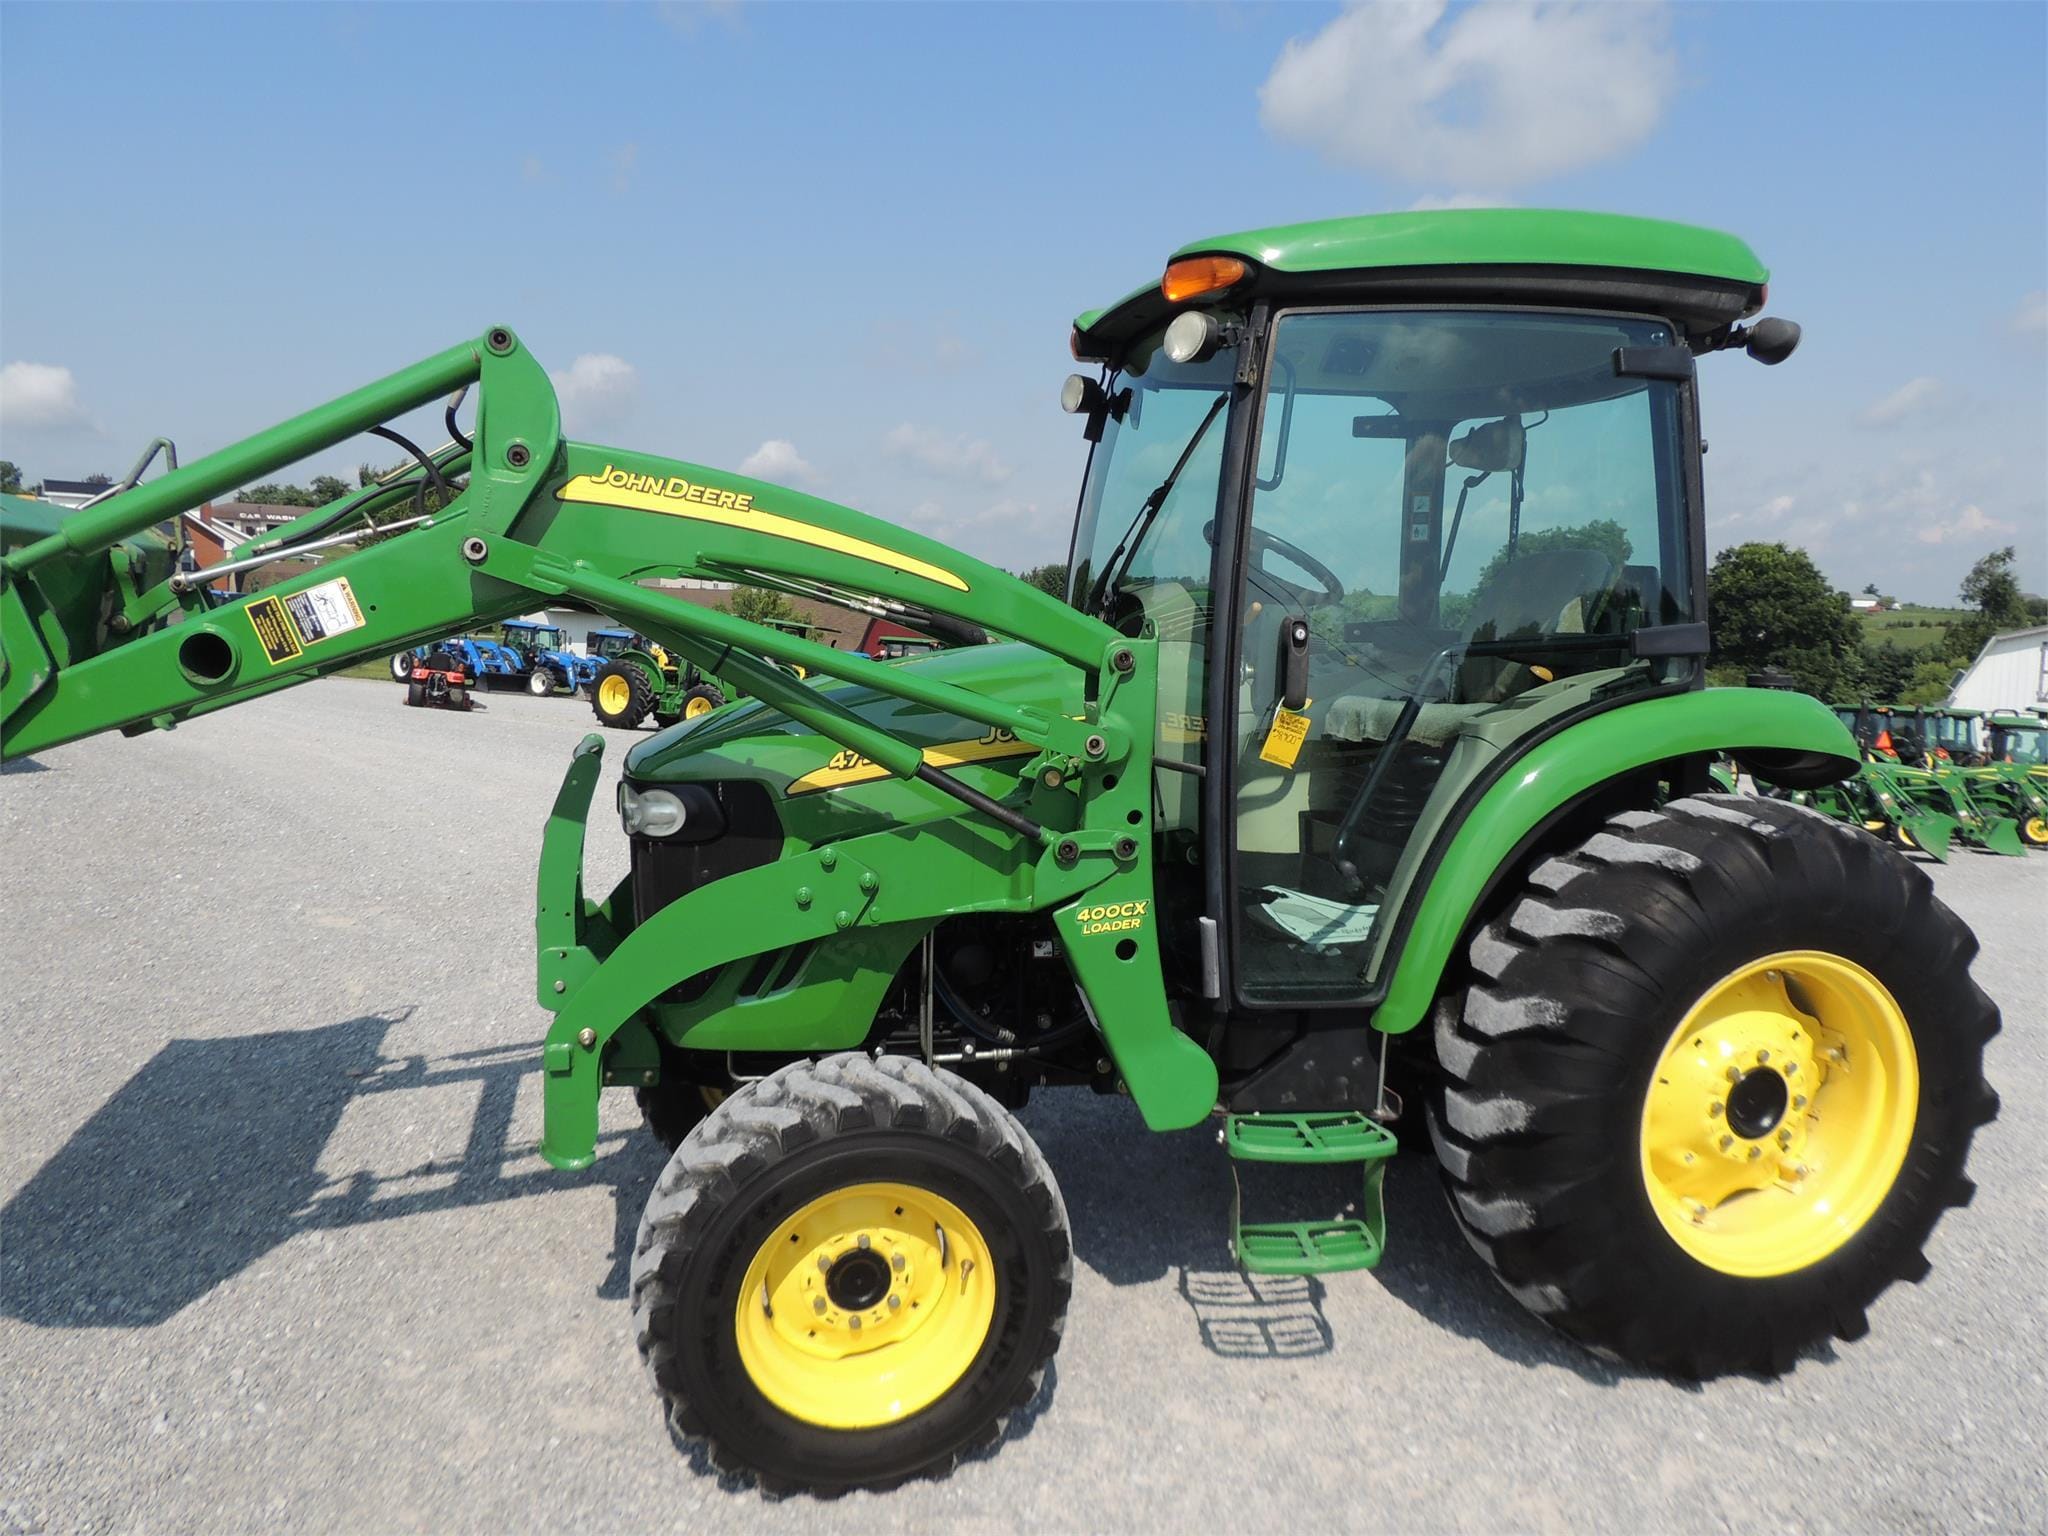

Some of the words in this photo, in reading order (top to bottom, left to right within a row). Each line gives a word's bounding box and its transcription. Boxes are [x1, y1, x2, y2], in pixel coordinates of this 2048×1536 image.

[590, 464, 666, 495] JOHN
[663, 477, 755, 512] DEERE
[239, 512, 261, 520] CAR
[829, 750, 872, 771] 47
[1076, 901, 1149, 922] 400CX
[1082, 918, 1142, 936] LOADER
